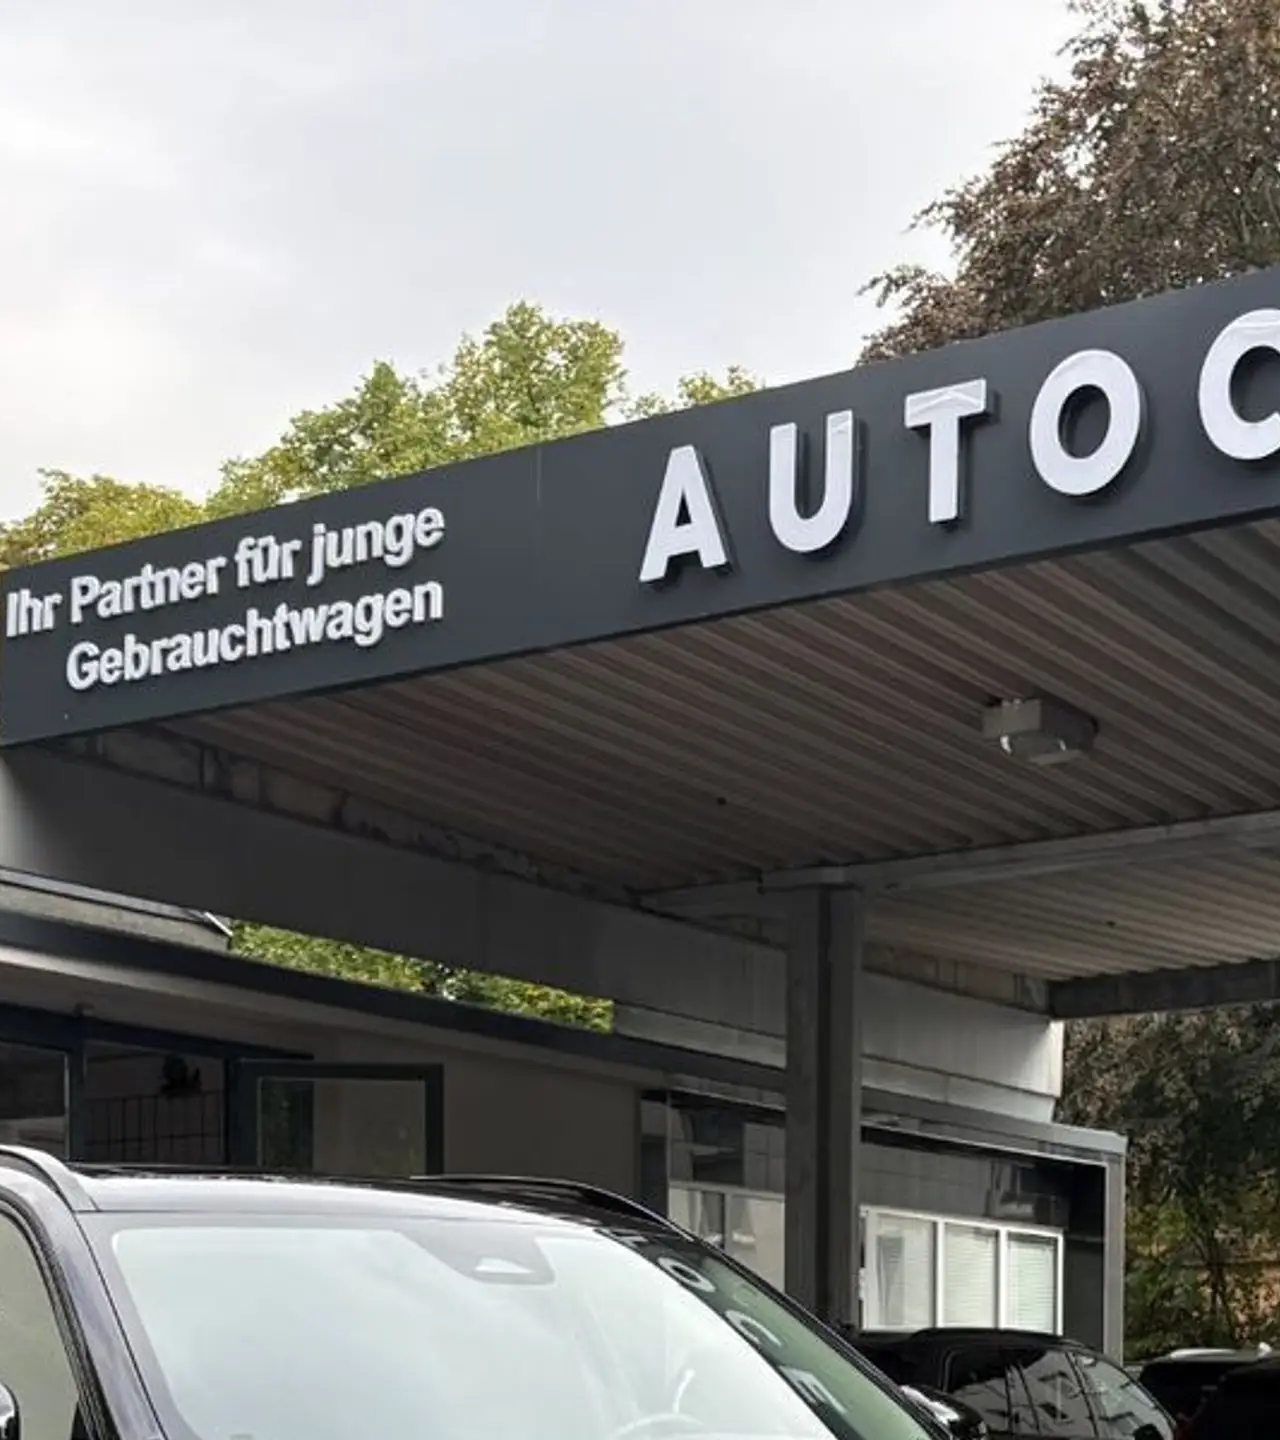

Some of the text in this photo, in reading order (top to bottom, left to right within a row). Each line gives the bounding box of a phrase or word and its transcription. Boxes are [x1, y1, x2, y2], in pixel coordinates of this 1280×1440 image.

[6, 507, 446, 637] Ihr Partner für junge
[66, 579, 445, 691] Gebrauchtwagen
